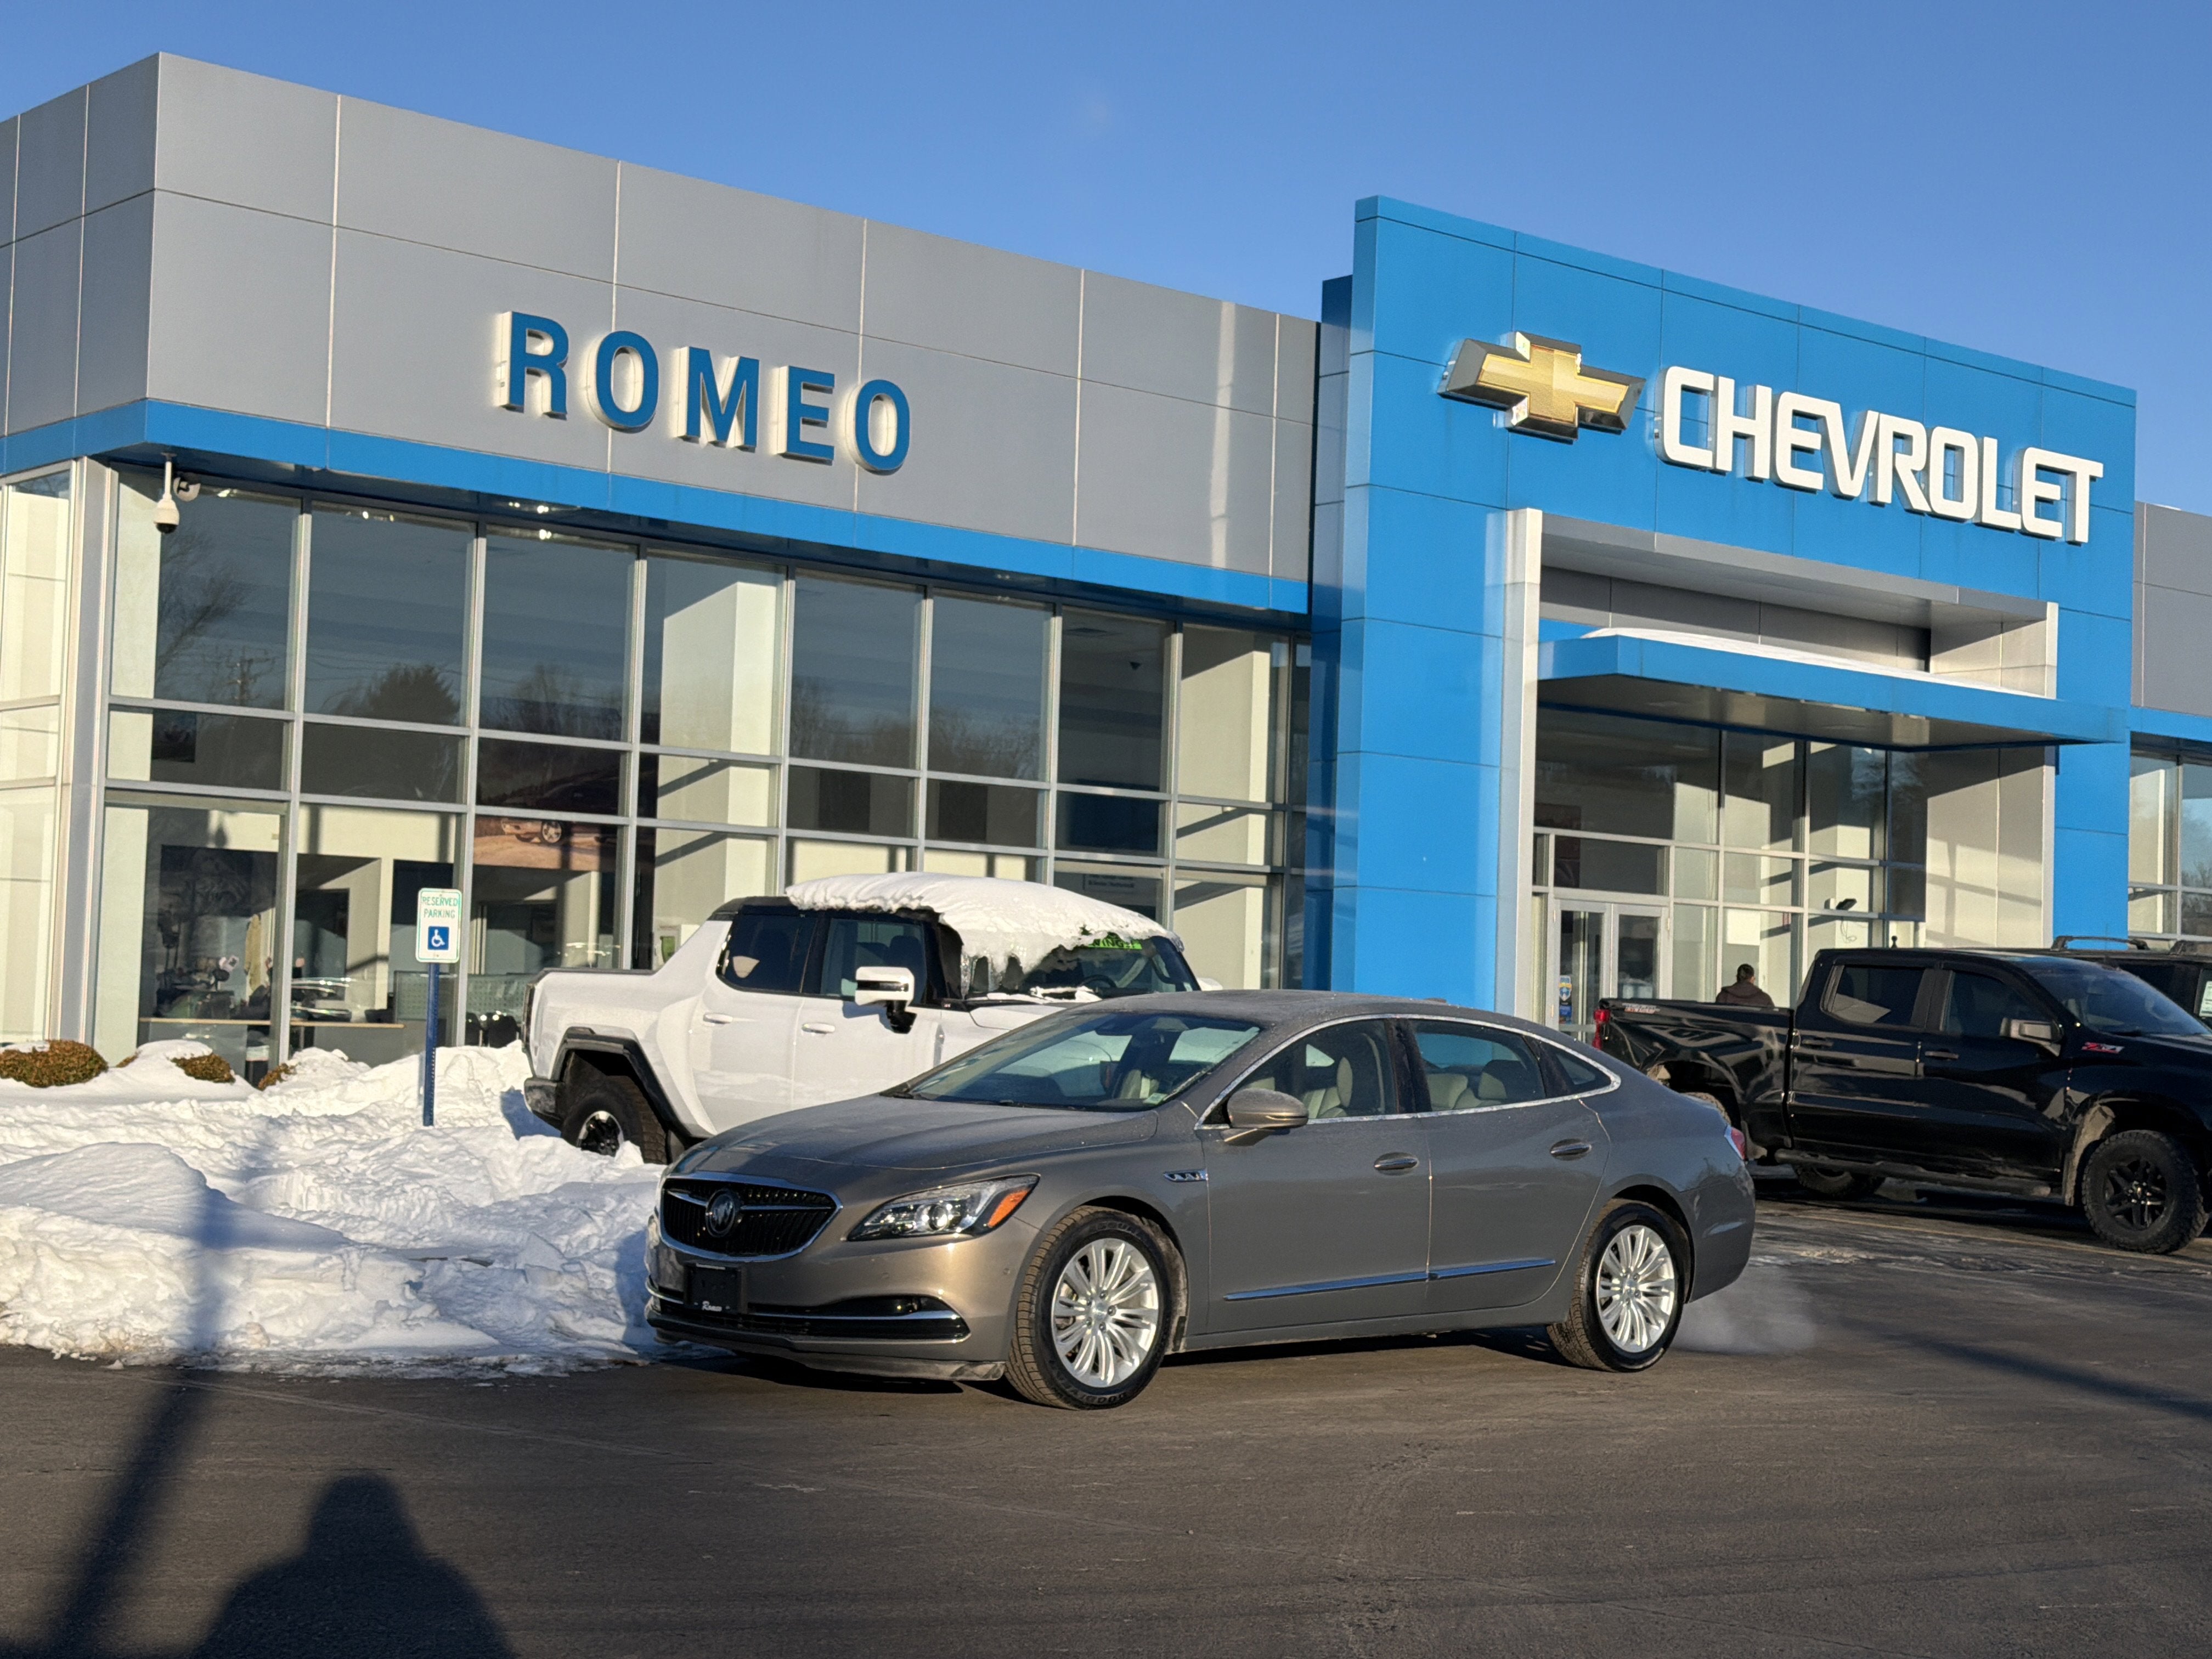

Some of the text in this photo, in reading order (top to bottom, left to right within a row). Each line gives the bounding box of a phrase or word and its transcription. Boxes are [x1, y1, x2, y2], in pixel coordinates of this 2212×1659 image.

[501, 311, 911, 473] ROMEO
[1658, 365, 2103, 545] CHEVROLET
[421, 896, 458, 906] RESERVED
[424, 908, 455, 918] PARKING
